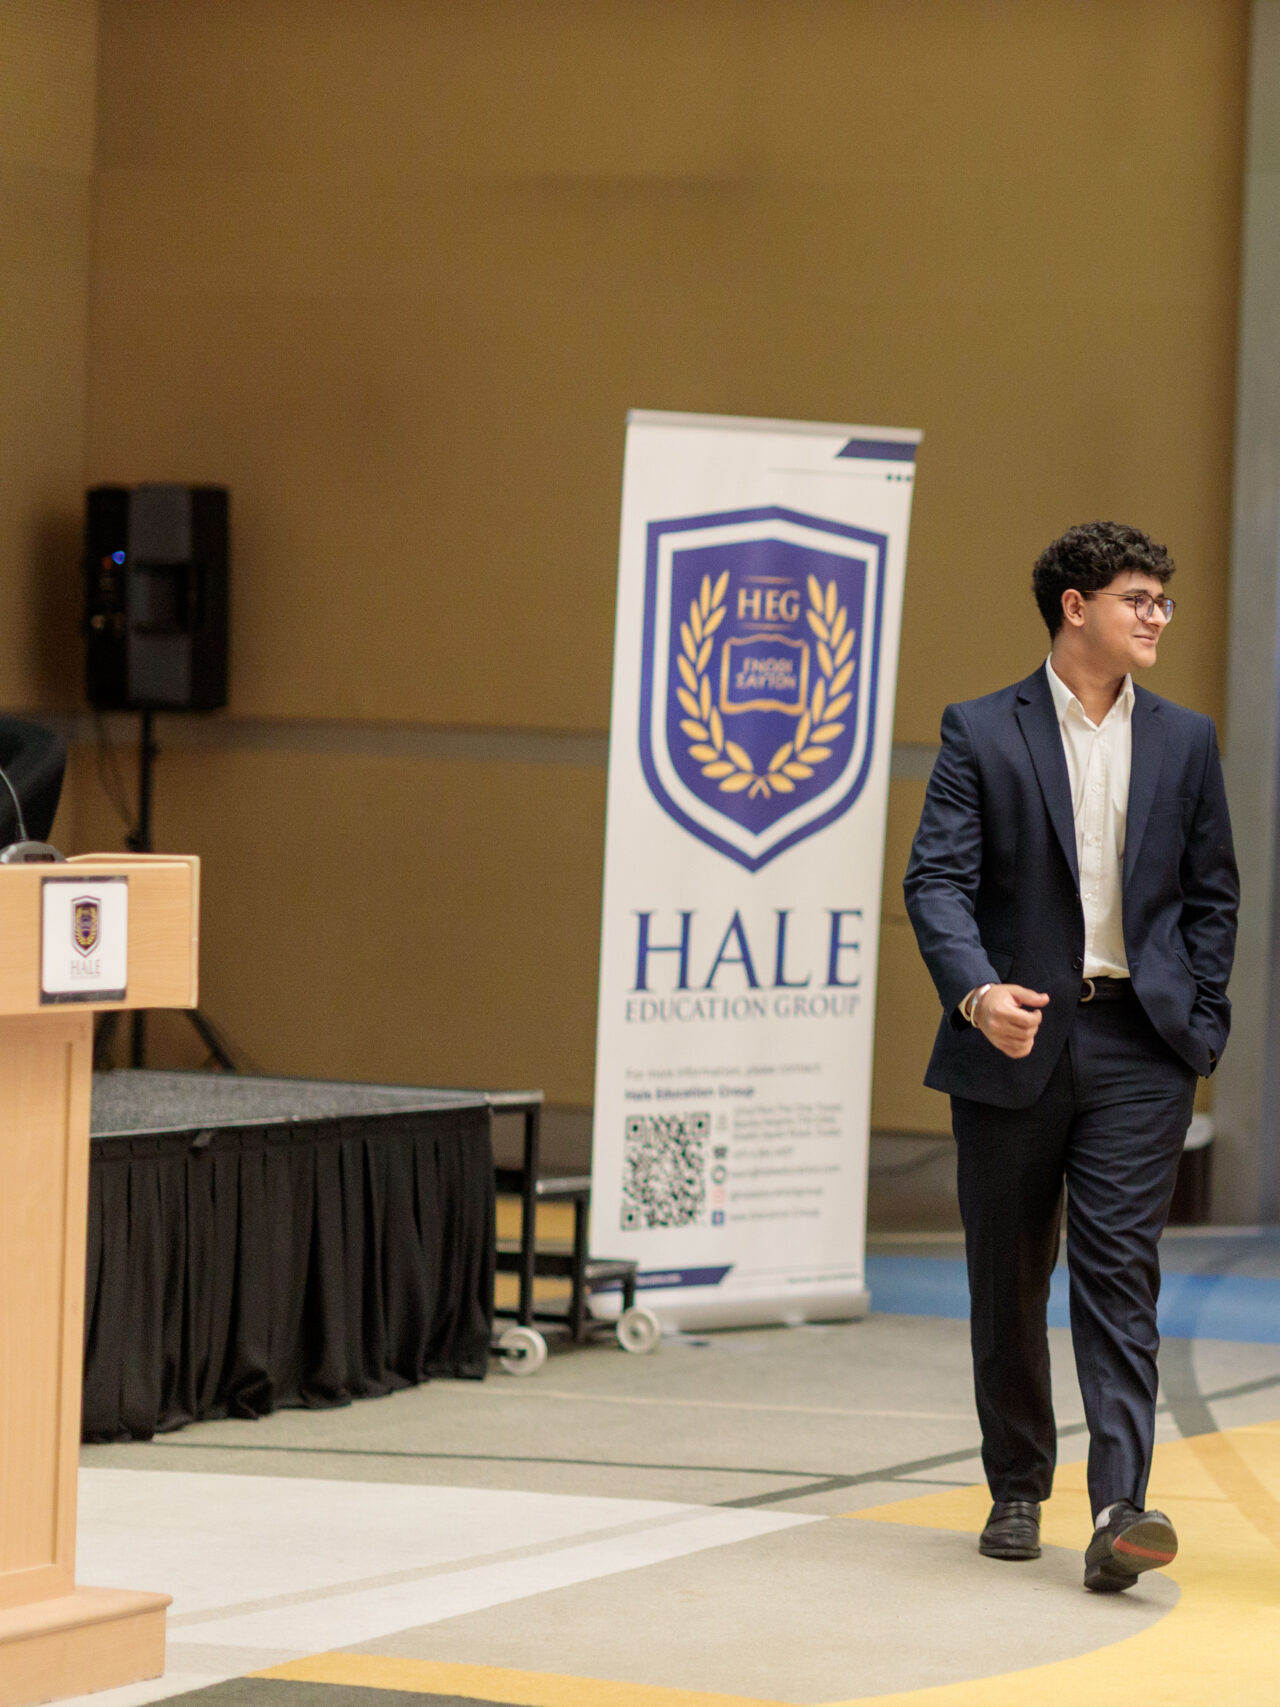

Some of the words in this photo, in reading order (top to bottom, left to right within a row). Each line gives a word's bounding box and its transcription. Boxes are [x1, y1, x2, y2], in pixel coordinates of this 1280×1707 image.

[738, 587, 800, 622] HEG
[630, 908, 863, 992] HALE
[71, 959, 101, 975] HALE
[625, 996, 767, 1023] EDUCATION
[774, 993, 862, 1019] GROUP
